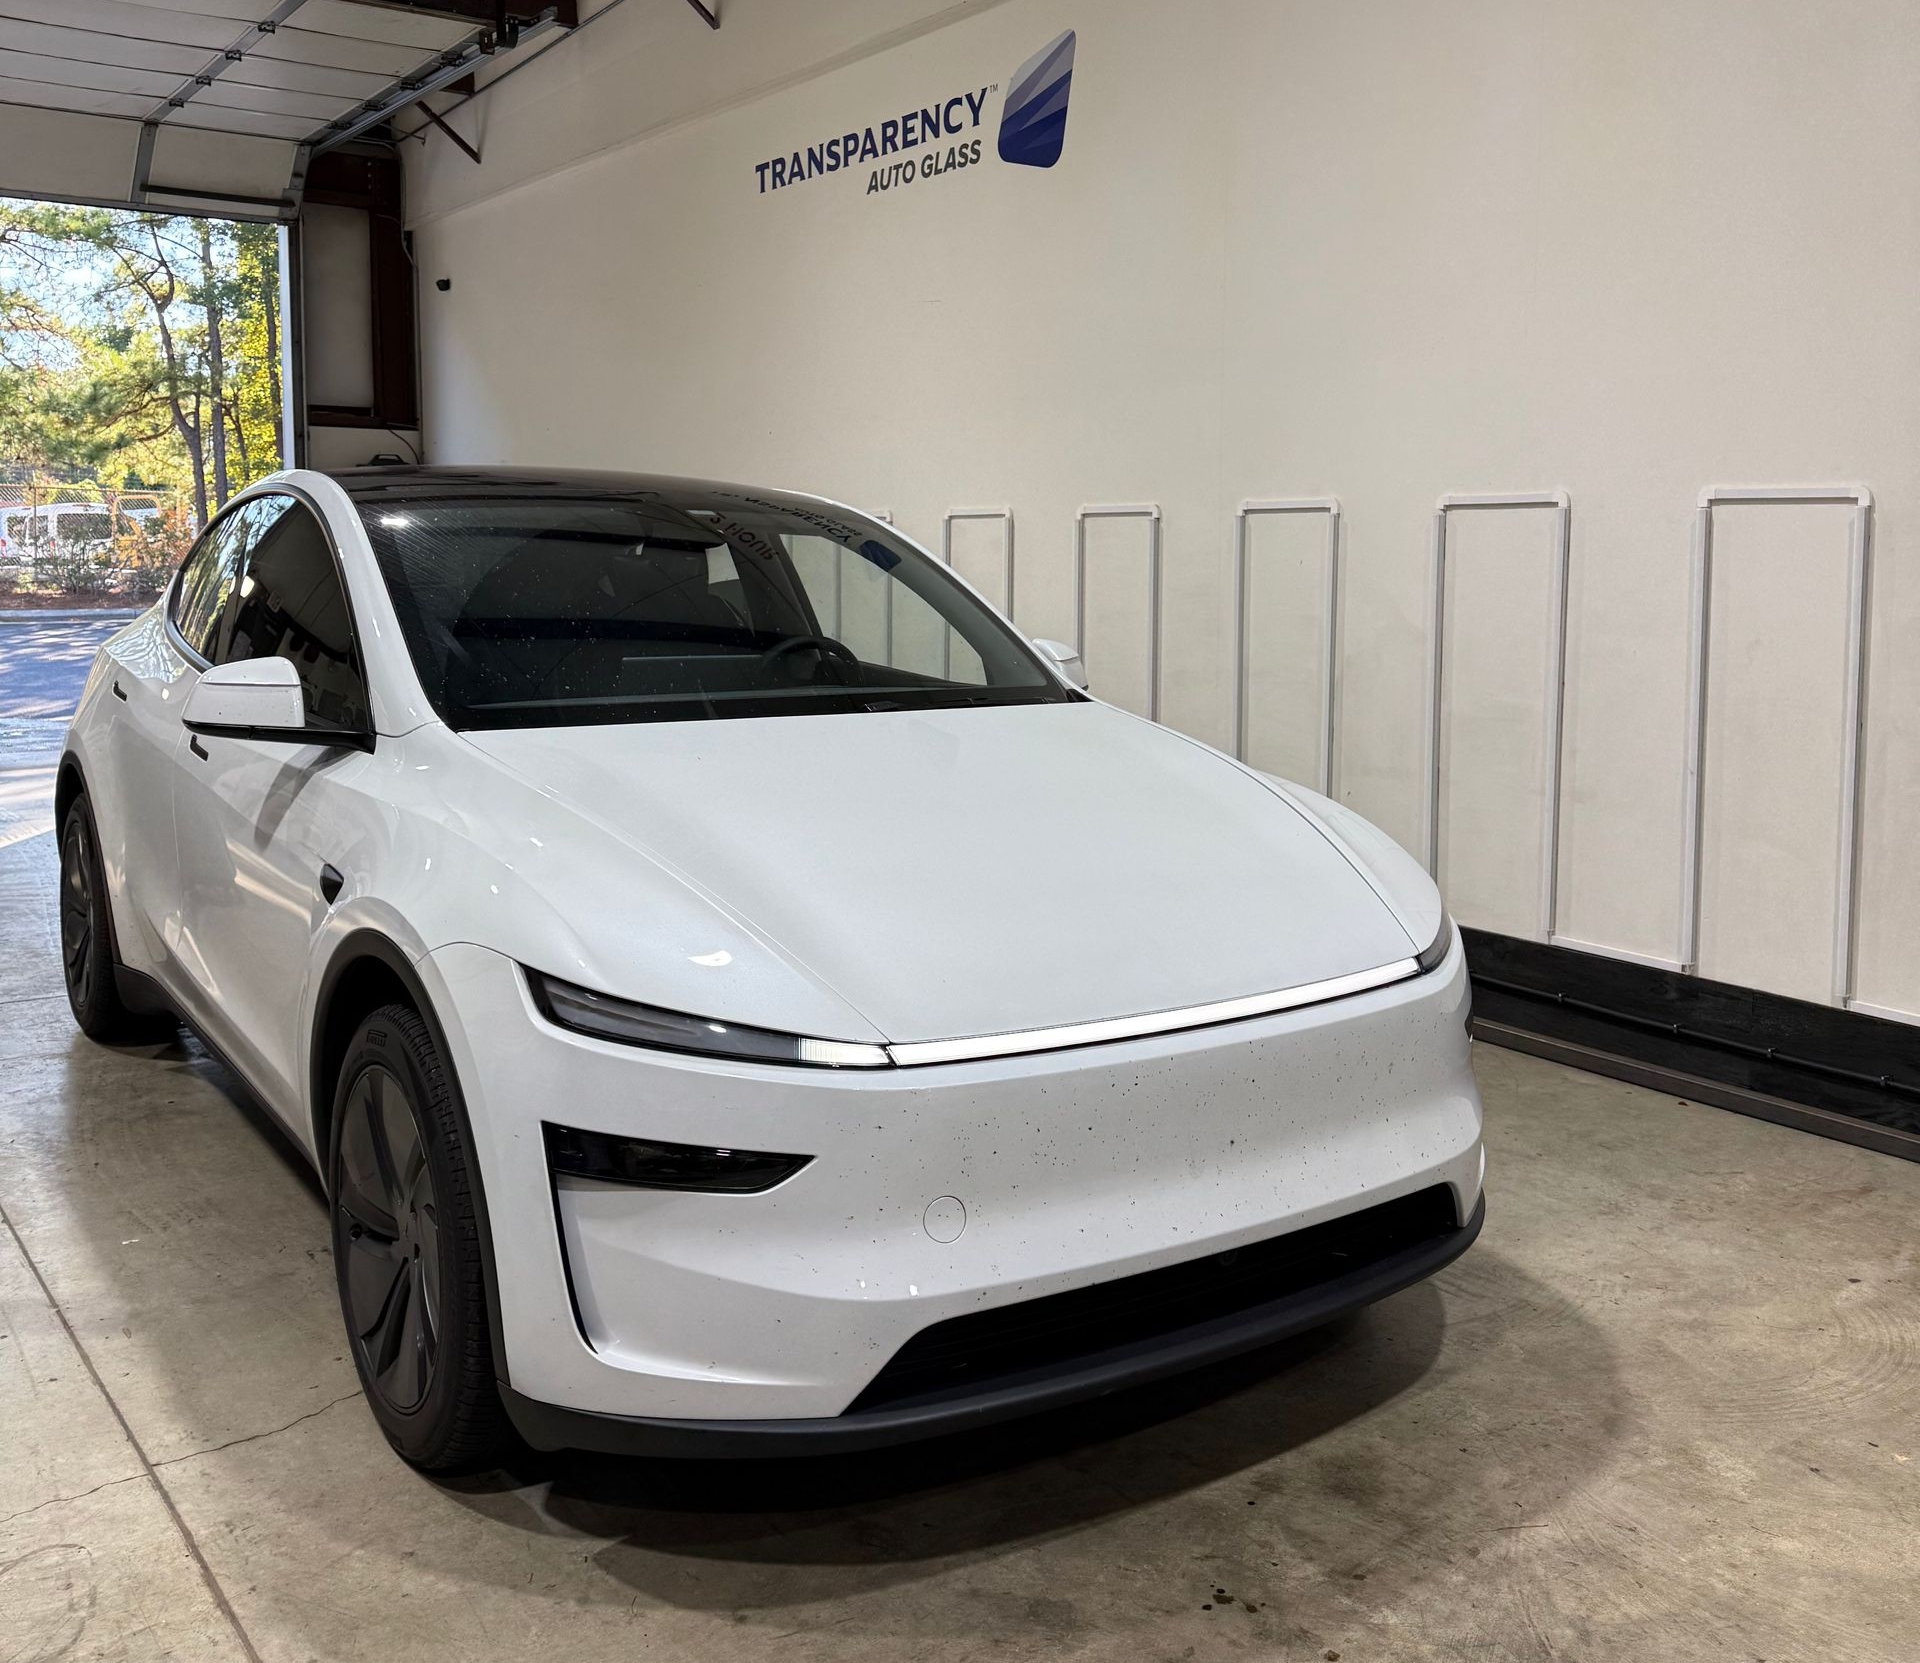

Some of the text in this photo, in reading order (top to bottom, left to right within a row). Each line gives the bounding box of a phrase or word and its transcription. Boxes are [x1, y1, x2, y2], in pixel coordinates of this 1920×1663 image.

[755, 87, 988, 193] TRANSPARENCY
[867, 139, 982, 194] AUTO GLASS
